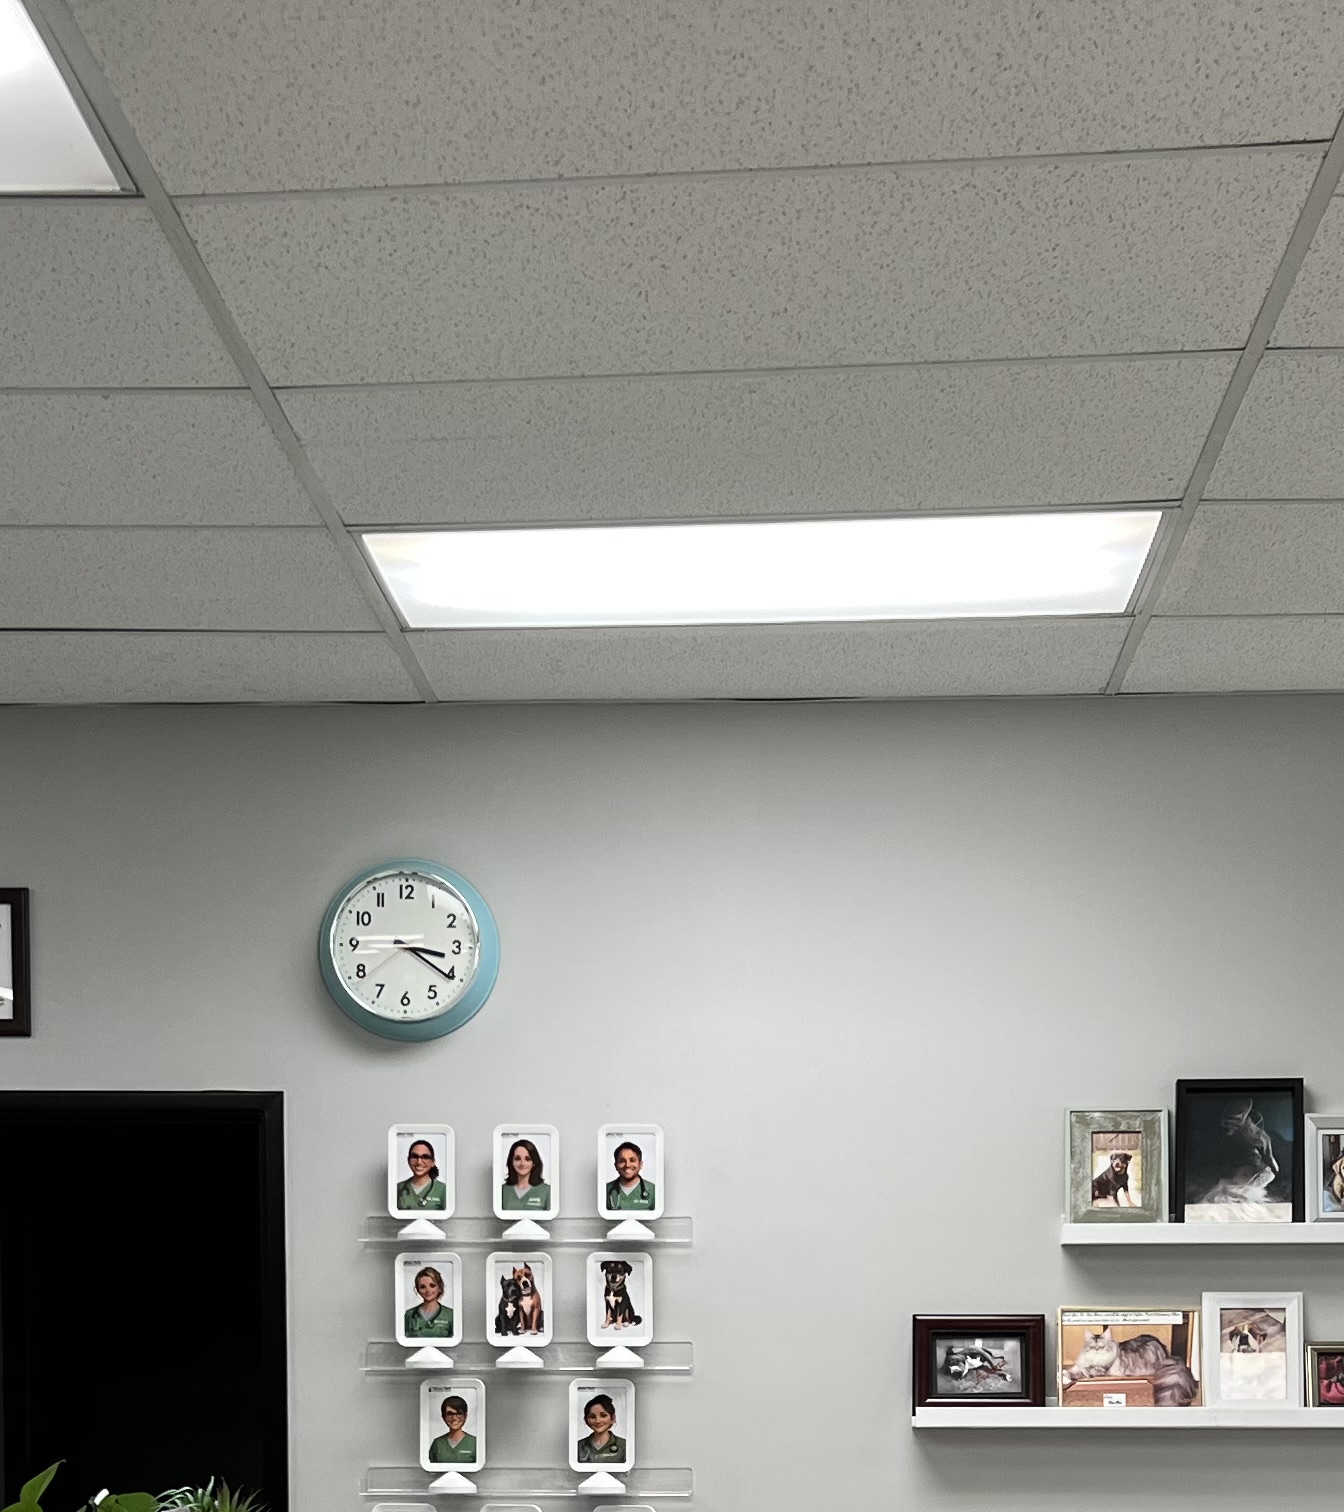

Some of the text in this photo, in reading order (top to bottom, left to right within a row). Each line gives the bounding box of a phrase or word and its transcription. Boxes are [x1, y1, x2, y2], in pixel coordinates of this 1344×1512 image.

[376, 892, 385, 908] 11
[398, 884, 415, 900] 12
[356, 910, 372, 927] 10
[446, 913, 457, 929] 2
[348, 937, 360, 953] 9
[451, 939, 462, 955] 3
[355, 963, 367, 979] 8
[445, 965, 456, 981] 4
[374, 983, 386, 999] 7
[400, 991, 411, 1007] 6
[427, 984, 438, 1000] 5
